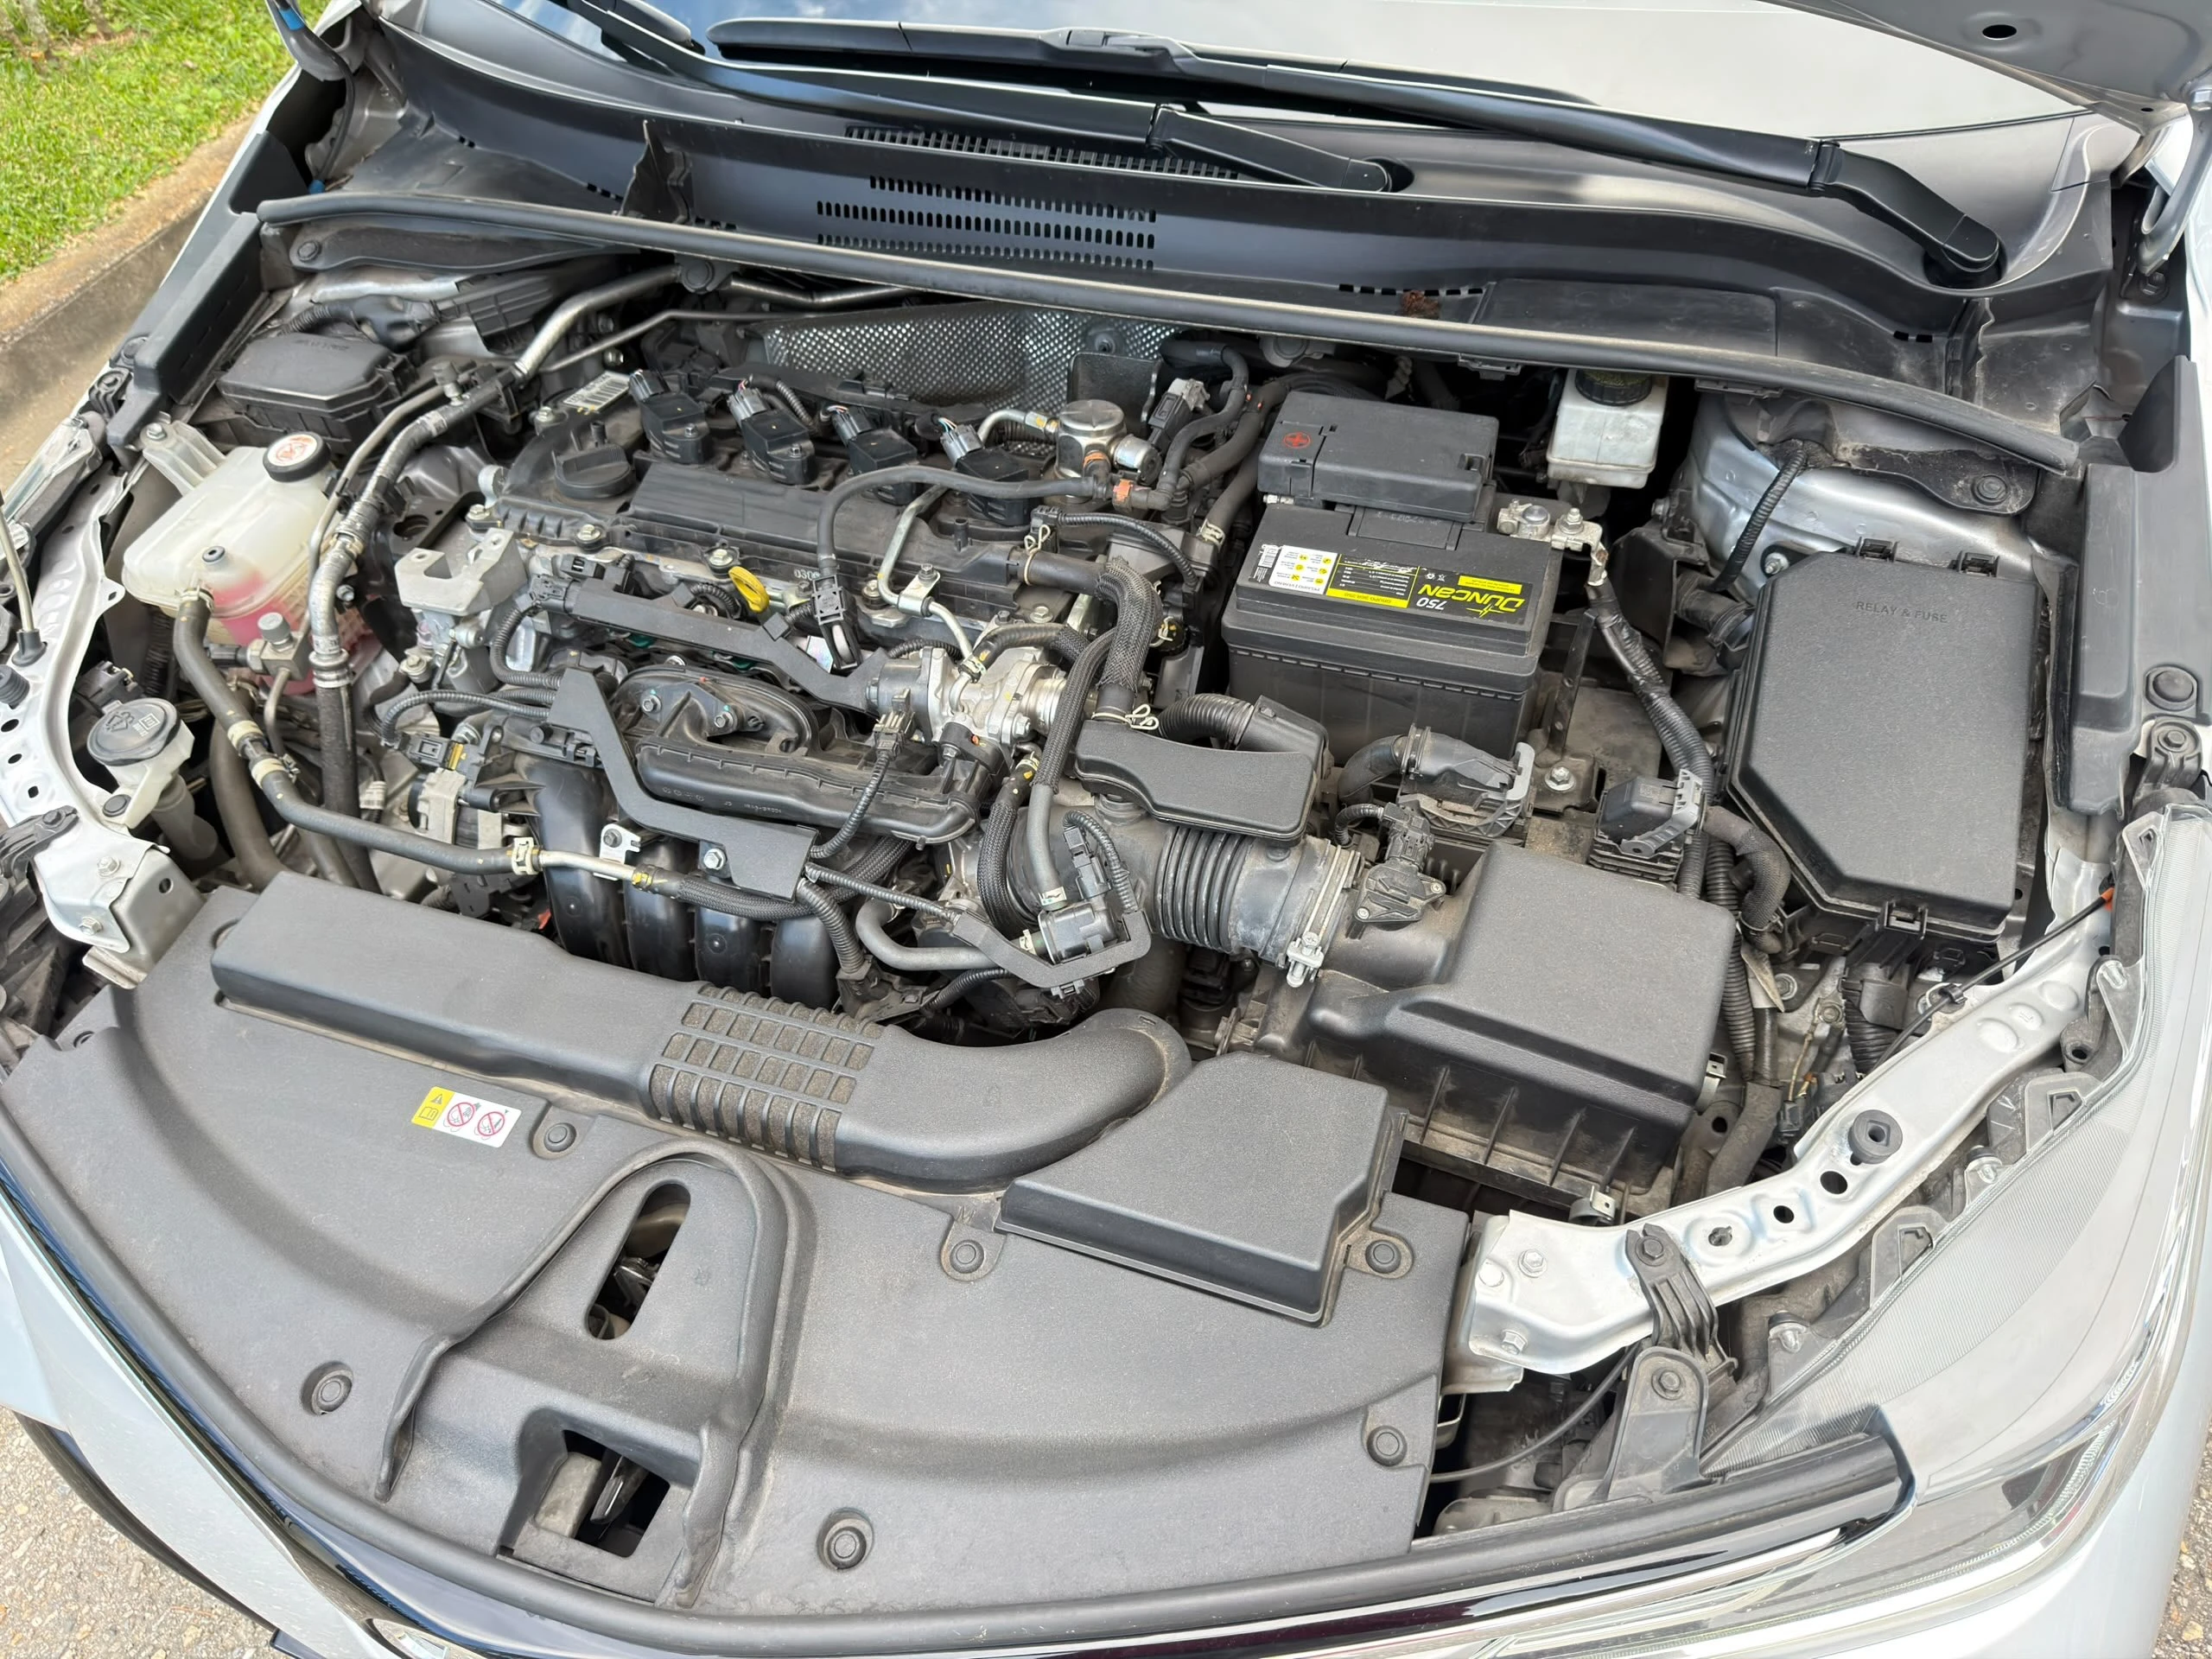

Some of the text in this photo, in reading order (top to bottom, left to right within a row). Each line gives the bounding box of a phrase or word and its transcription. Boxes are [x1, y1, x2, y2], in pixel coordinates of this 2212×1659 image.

[1416, 597, 1447, 610] 750
[1855, 601, 1948, 623] RELAY & FUSE
